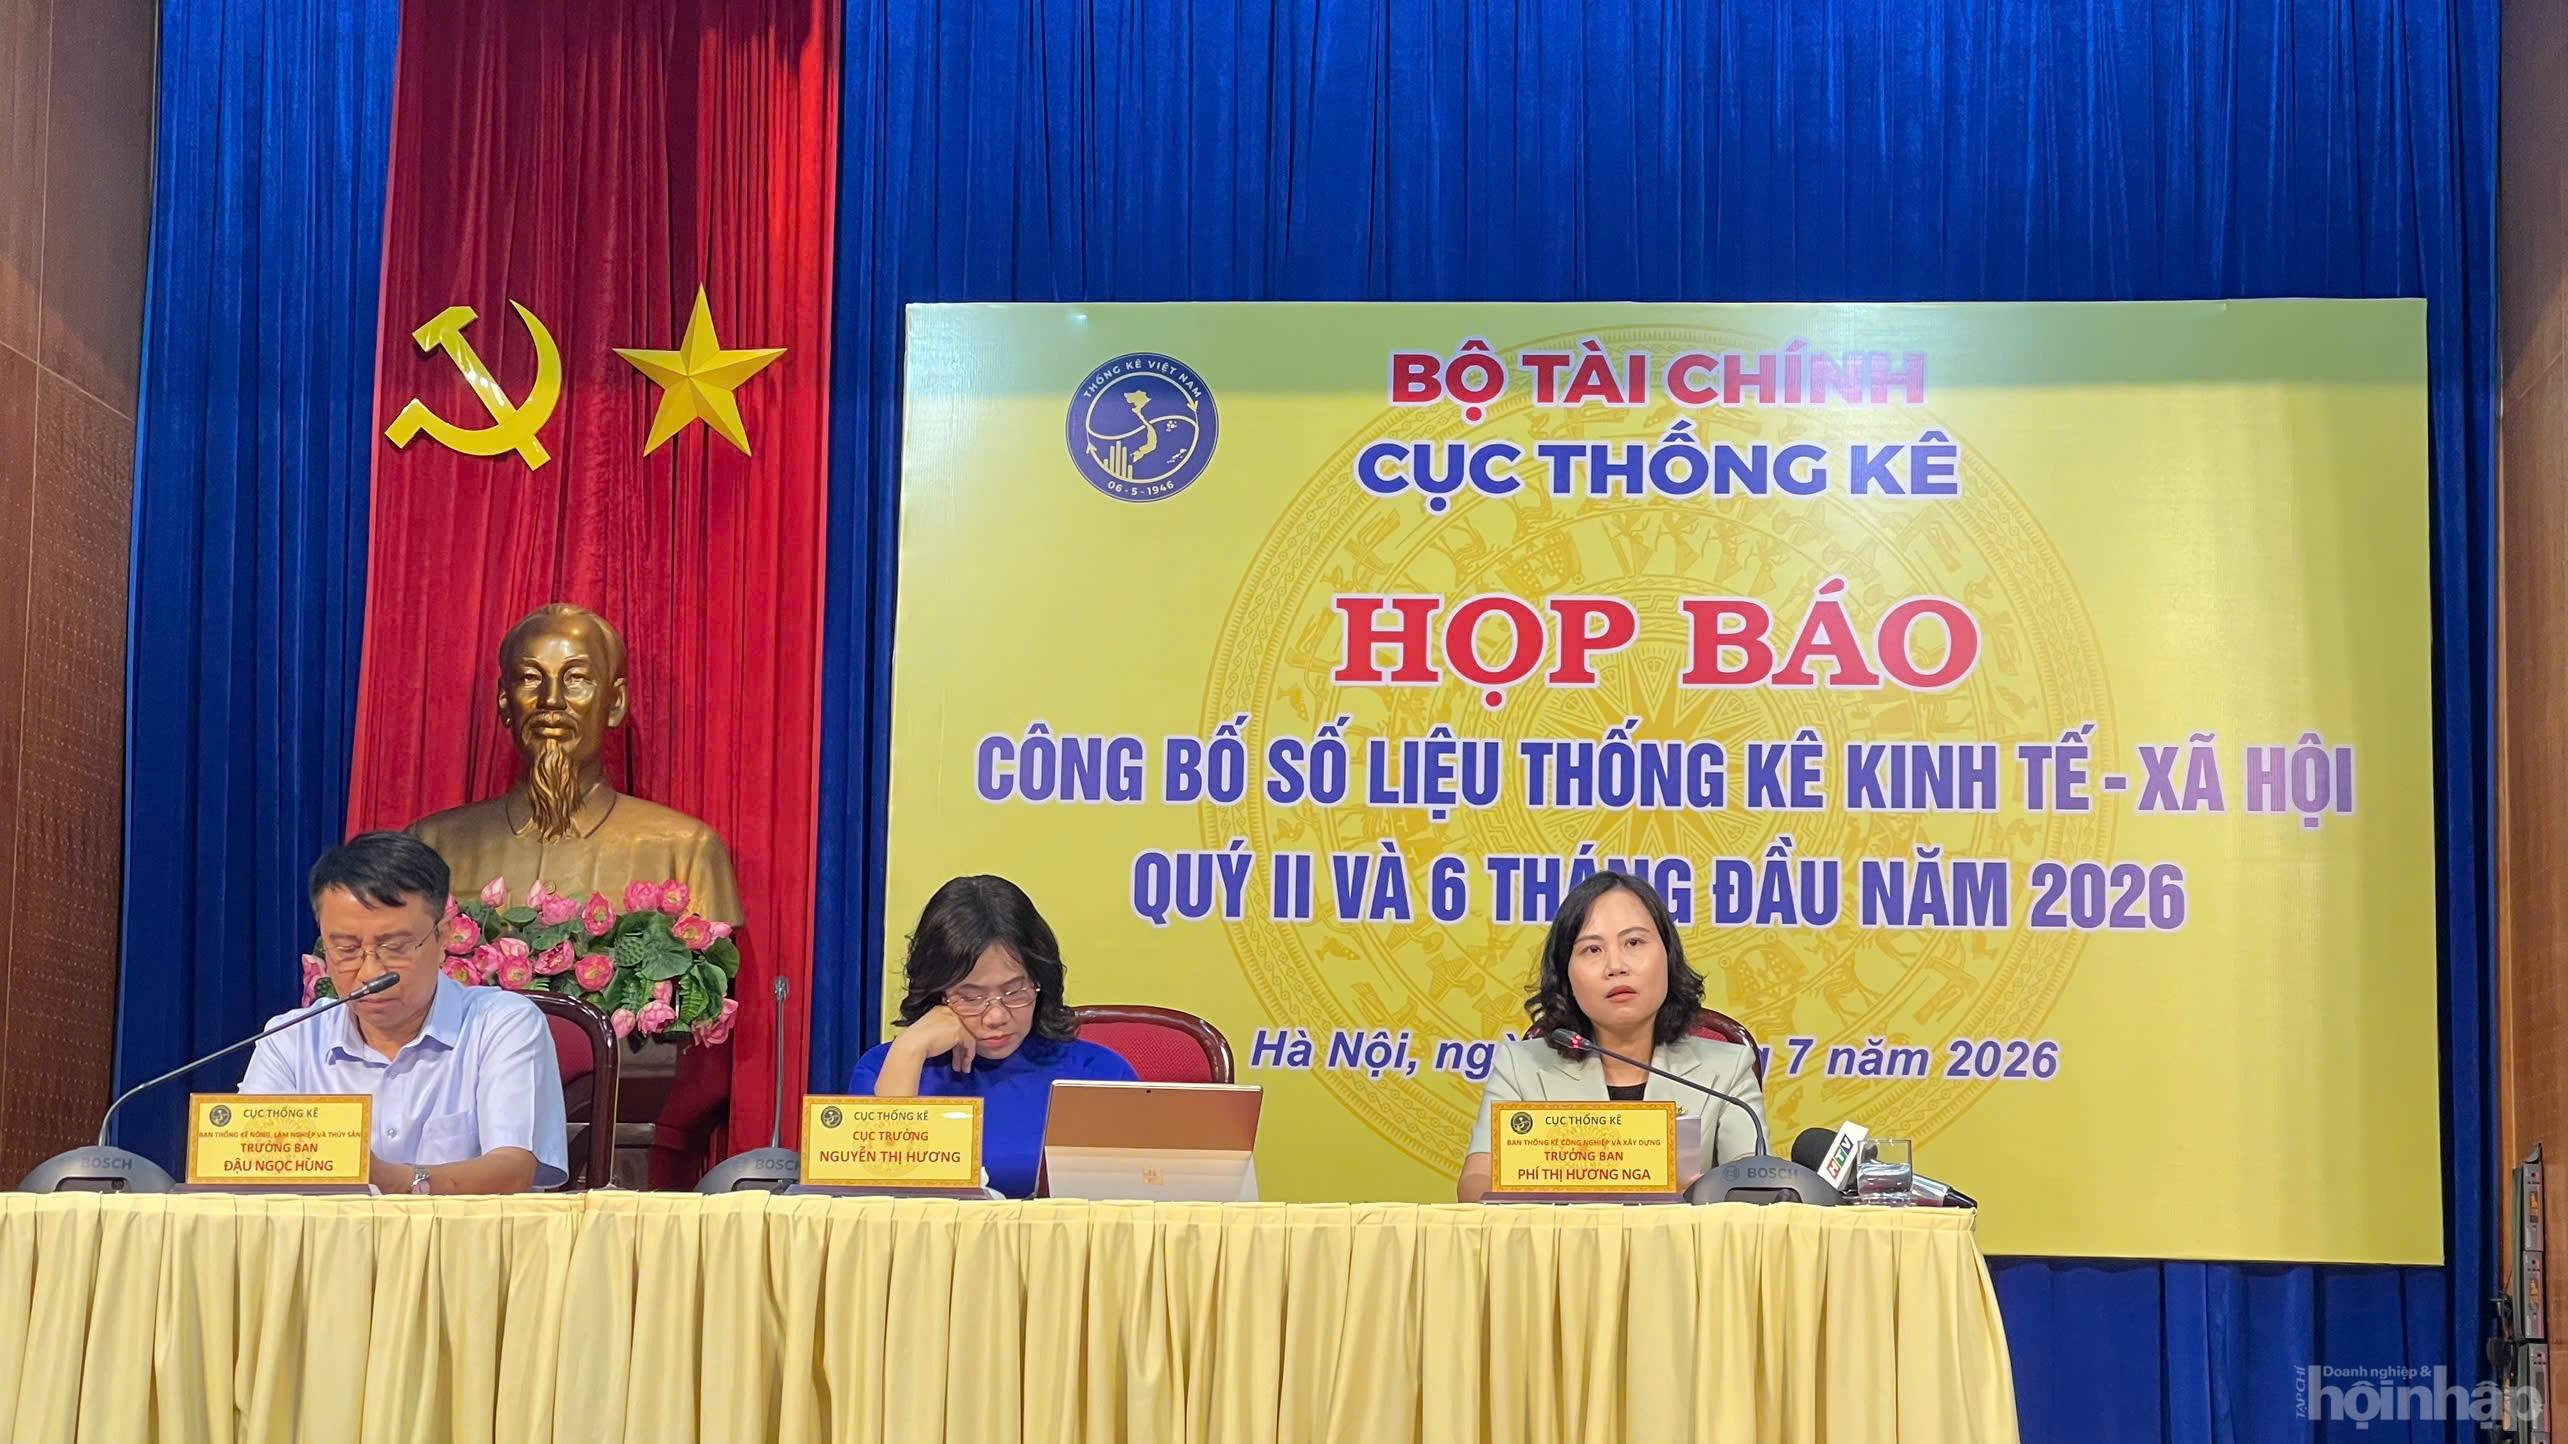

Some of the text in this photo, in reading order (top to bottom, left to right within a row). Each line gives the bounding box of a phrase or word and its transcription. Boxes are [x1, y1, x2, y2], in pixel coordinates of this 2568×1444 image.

[1125, 358, 1142, 370] KÊ
[1148, 360, 1177, 375] VIỆT
[1178, 372, 1202, 398] NAM
[1390, 337, 1927, 423] BỘ TÀI CHÍNH
[1357, 419, 1960, 513] CỤC THỐNG KÊ
[1108, 480, 1123, 493] 06
[1147, 480, 1174, 496] 1946
[1334, 578, 1978, 708] HỌP BÁO
[978, 723, 1144, 802] CÔNG
[1165, 715, 1248, 804] BỐ
[1266, 716, 1350, 805] SỐ
[1368, 726, 1500, 821] LIỆU
[1520, 718, 1725, 809] THỐNG
[1747, 729, 1824, 809] KÊ
[1847, 744, 1997, 810] KINH
[2017, 725, 2095, 811] TẾ
[2139, 734, 2223, 811] XÃ
[2247, 734, 2352, 828] HỘI
[1133, 836, 2185, 929] QUÝ II VÀ 6 THG ĐẦU NĂM 2026
[1251, 1030, 1312, 1067] Hà
[1328, 1031, 1417, 1078] Nội,
[1788, 1038, 1813, 1075] 7
[1827, 1038, 1929, 1076] năm
[1947, 1040, 2059, 1078] 2026
[243, 1107, 320, 1119] CỤC THỐNG KÊ
[855, 1109, 929, 1121] CỤC THỐNG KÊ
[1545, 1113, 1622, 1126] CỤC THỐNG KÊ
[852, 1128, 929, 1142] CỤC TRƯỞNG
[241, 1141, 318, 1153] TRƯỞNG BAN
[820, 1146, 961, 1165] NGUYỄN THỊ HƯƠNG
[1544, 1148, 1624, 1161] TRƯỞNG BAN
[80, 1157, 133, 1170] BOSCH
[224, 1157, 334, 1174] ĐẬU NGỌC HÙNG
[1826, 1134, 1855, 1180] HTV
[1518, 1165, 1651, 1182] PHÍ THỊ HƯƠNG NGA
[1747, 1166, 1798, 1179] BOSCH
